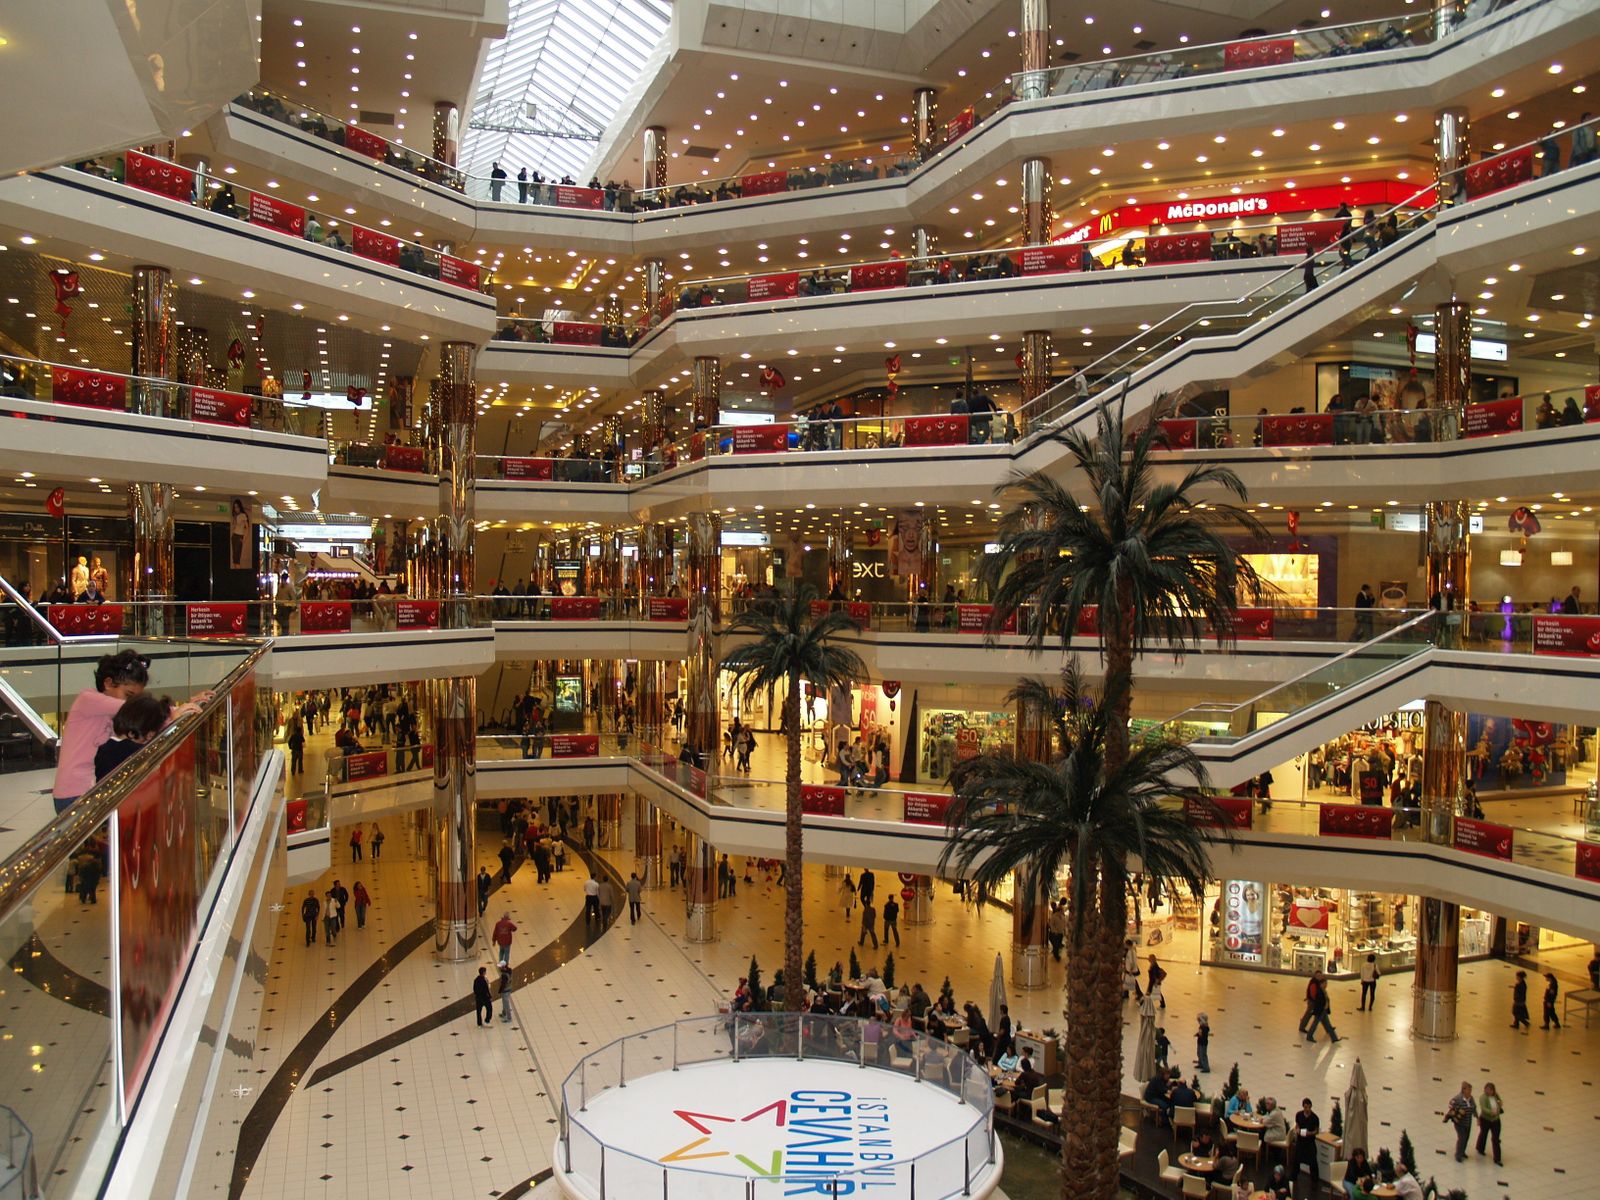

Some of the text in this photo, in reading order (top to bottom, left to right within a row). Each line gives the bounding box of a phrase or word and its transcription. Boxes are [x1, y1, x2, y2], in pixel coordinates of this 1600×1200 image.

[1168, 198, 1268, 219] McDonald's
[1361, 711, 1425, 731] OPSHO
[961, 728, 977, 743] 50
